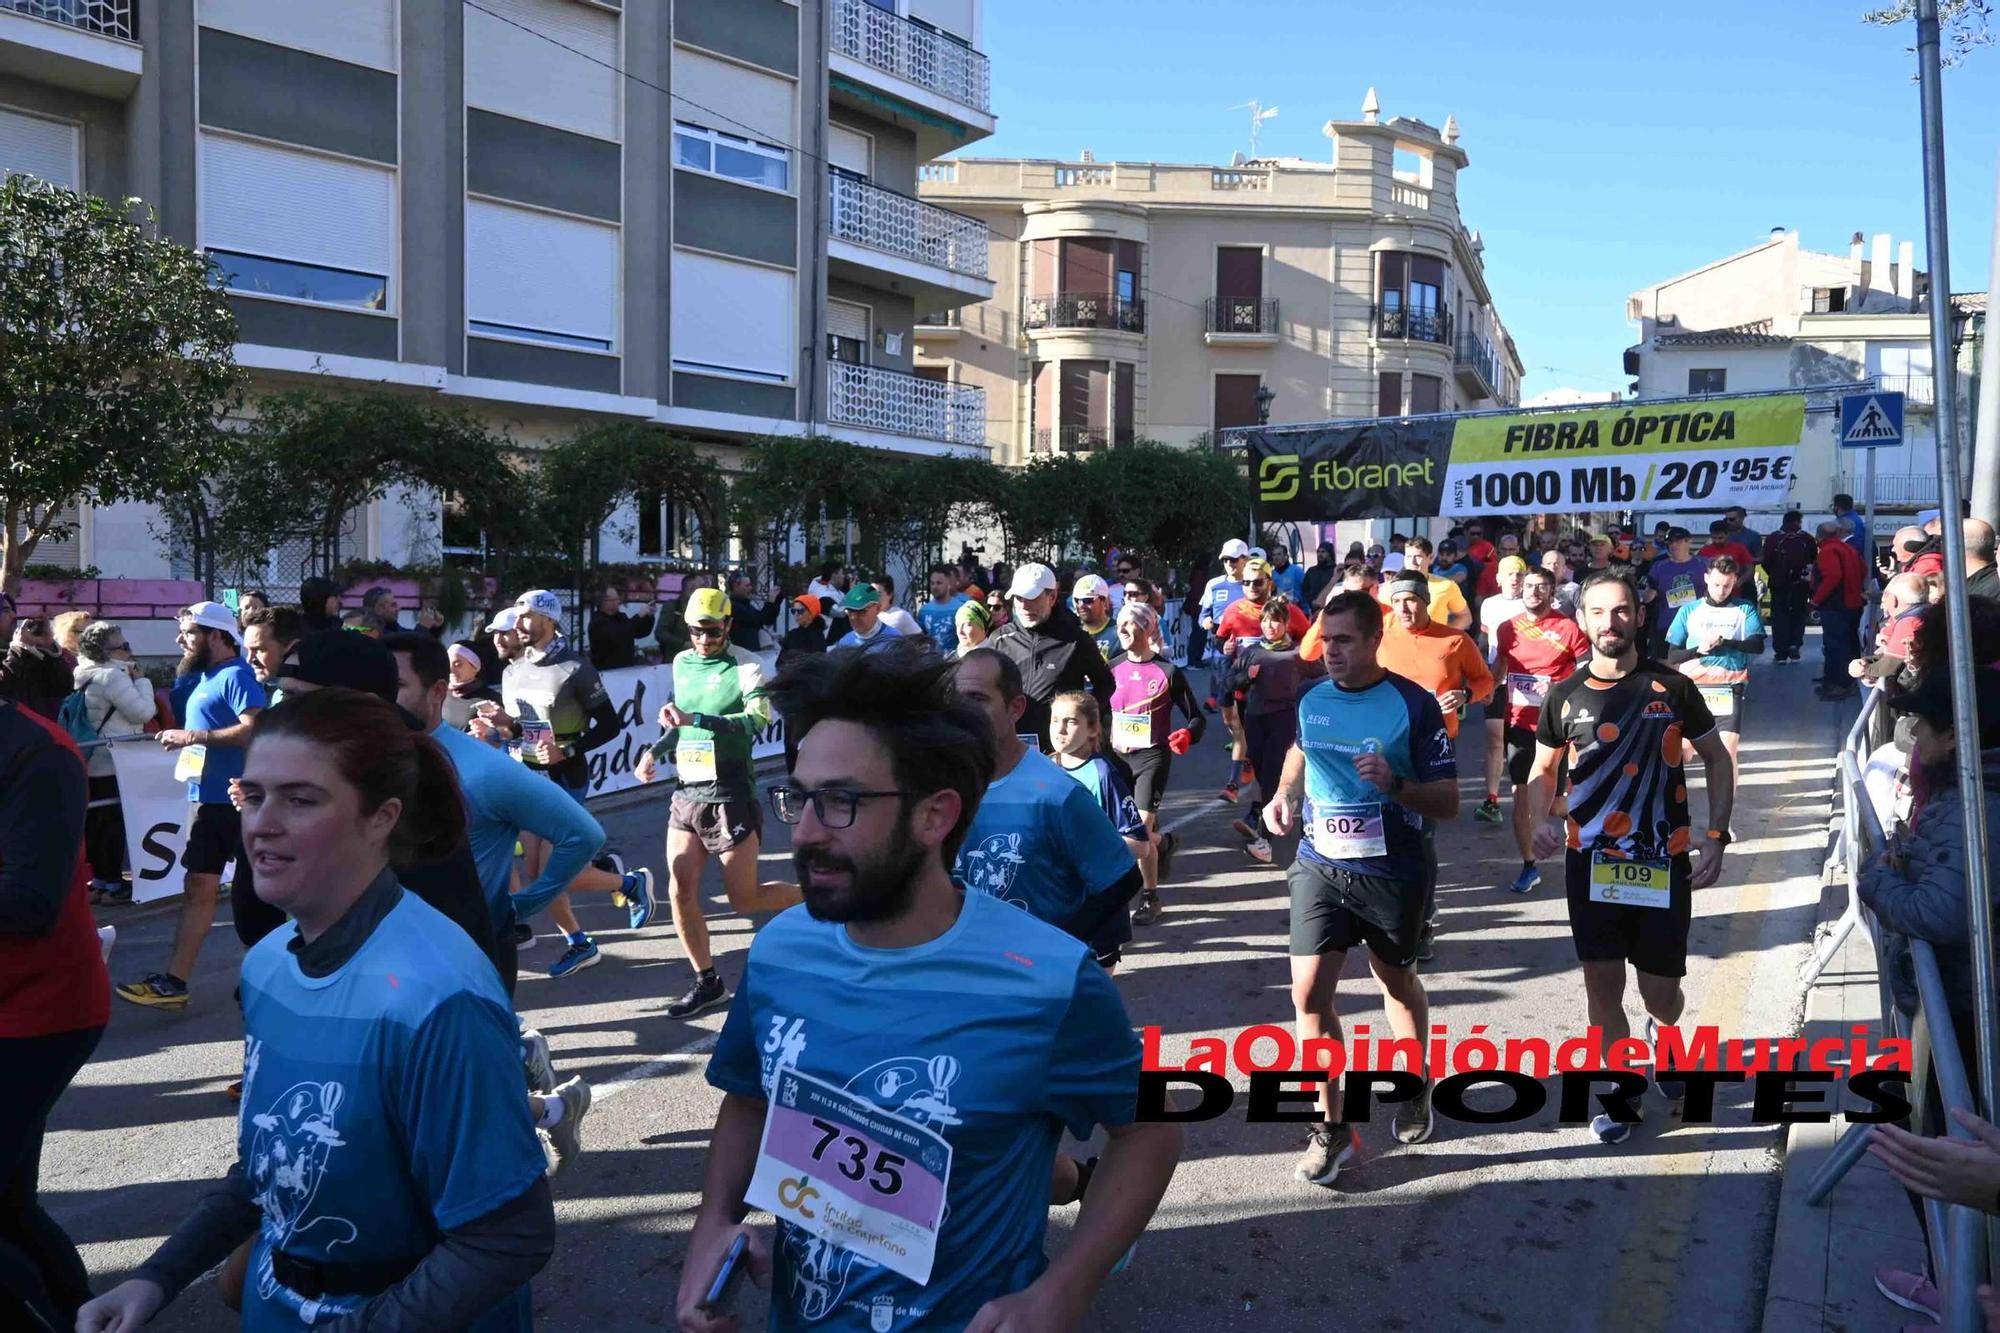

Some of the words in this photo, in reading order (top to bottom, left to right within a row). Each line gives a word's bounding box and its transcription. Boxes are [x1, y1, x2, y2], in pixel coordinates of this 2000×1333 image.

[1504, 419, 1600, 454] FIBRA
[1609, 409, 1736, 446] ÓPTICA
[1310, 457, 1434, 491] fibranet
[1465, 473, 1561, 508] 1000
[1571, 466, 1636, 505] Mb
[1454, 479, 1464, 509] HASTA
[1326, 818, 1366, 834] 602
[1610, 864, 1652, 882] 109
[809, 1118, 907, 1196] 735
